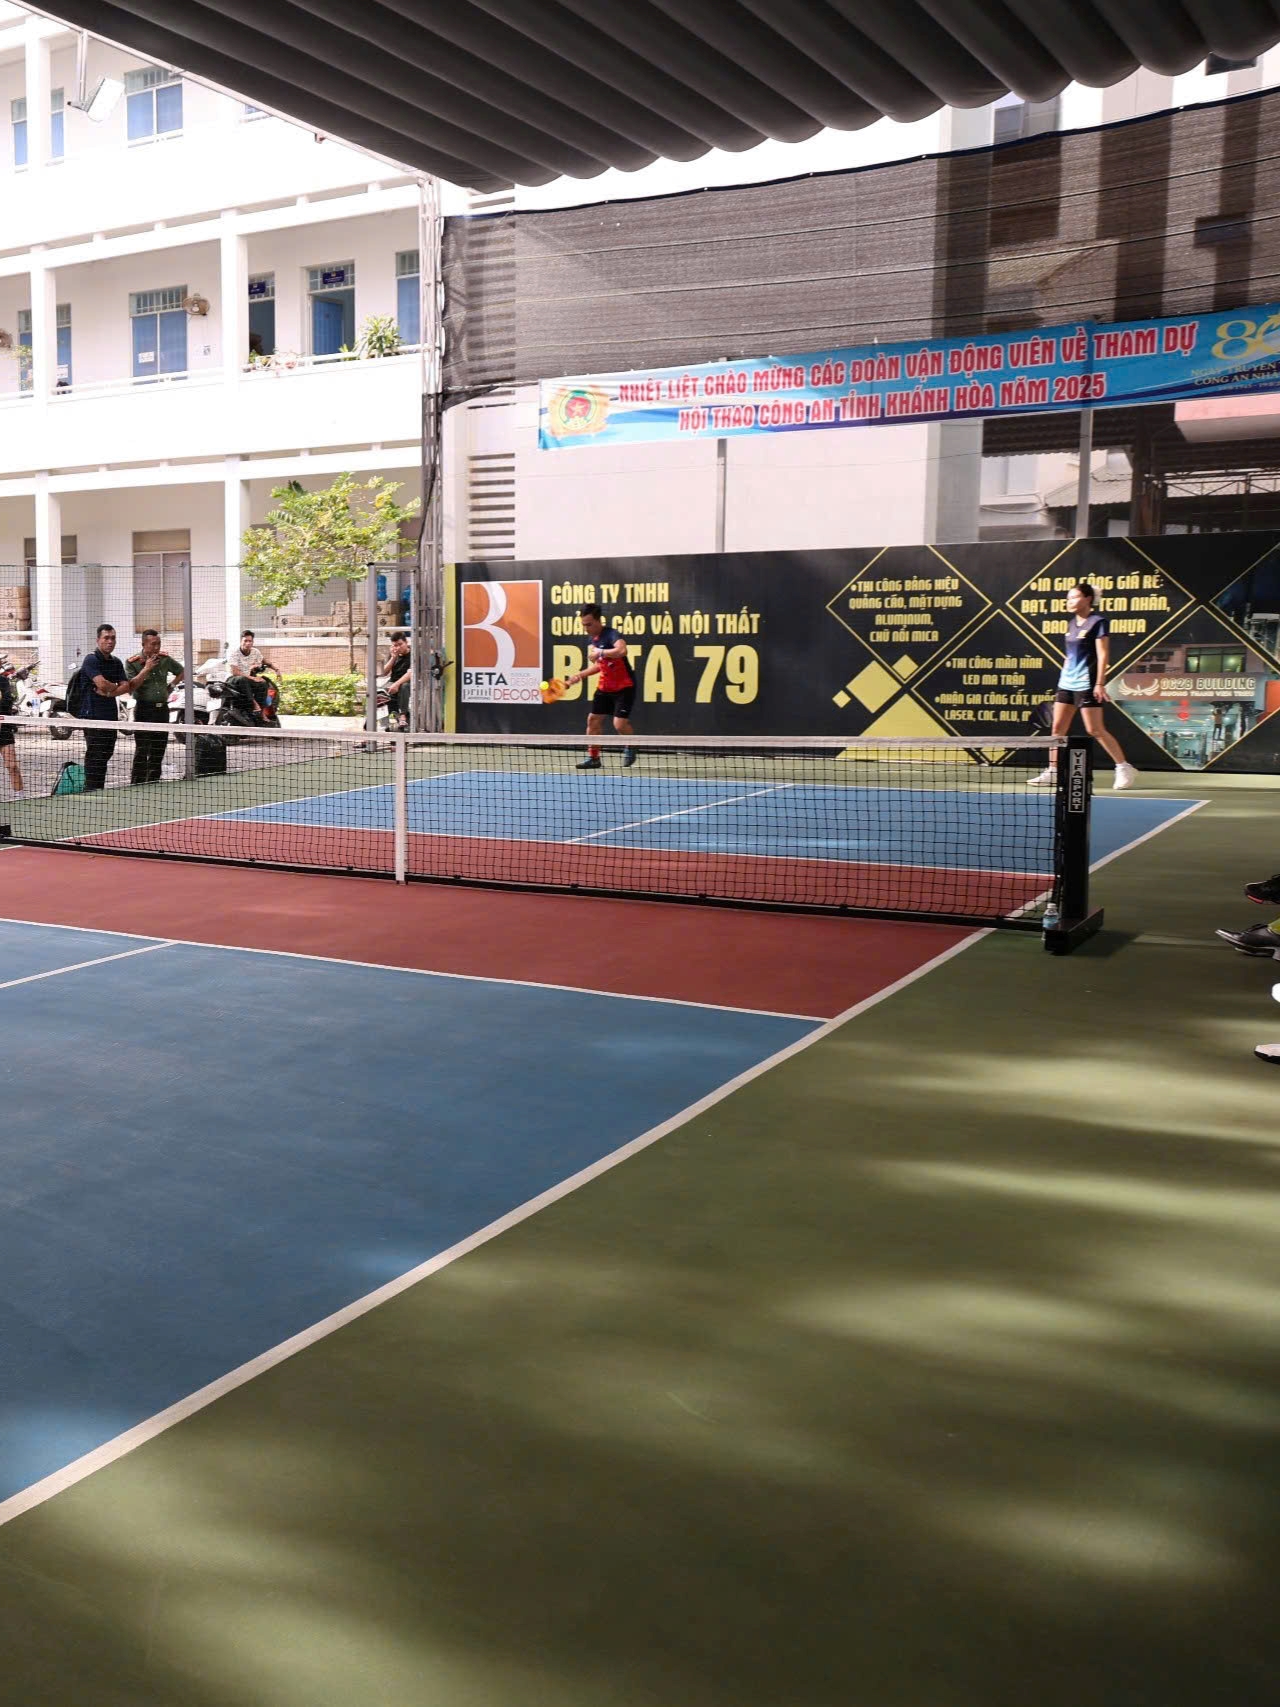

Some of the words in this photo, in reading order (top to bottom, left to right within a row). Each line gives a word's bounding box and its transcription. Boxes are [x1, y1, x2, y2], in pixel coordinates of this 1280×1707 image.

[668, 375, 698, 403] LIỆT
[704, 370, 747, 396] CHÀO
[753, 367, 805, 393] MỪNG
[811, 361, 844, 387] CÁC
[850, 352, 900, 384] ĐOÀN
[906, 349, 942, 383] VẬN
[949, 344, 1002, 379] ĐỘNG
[1009, 337, 1056, 369] VIÊN
[1062, 326, 1087, 362] VỀ
[1093, 328, 1156, 358] THAM
[1163, 321, 1199, 356] DỰ
[679, 407, 707, 435] HỘI
[759, 399, 805, 426] CÔNG
[809, 399, 834, 421] AN
[839, 390, 881, 420] TỈNH
[885, 381, 948, 417] KHÁNH
[955, 380, 994, 411] HÒA
[1000, 376, 1047, 408] NĂM
[1053, 372, 1106, 401] 2025
[857, 581, 873, 592] THI
[875, 577, 902, 592] CÔNG
[904, 575, 932, 591] BẢNG
[934, 576, 959, 592] HIỆU
[1116, 571, 1140, 590] GIÁ
[551, 581, 595, 604] CÔNG
[600, 584, 619, 604] TY
[624, 582, 669, 603] TNHH
[848, 593, 882, 610] QUẢNG
[1099, 597, 1127, 611] TEM
[651, 611, 674, 635] VÀ
[679, 610, 710, 638] NỘI
[715, 606, 760, 634] THẤT
[1042, 620, 1068, 634] BAO
[1109, 618, 1147, 637] NHỰA
[911, 630, 939, 642] MICA
[952, 657, 967, 669] THI
[968, 655, 993, 669] CÔNG
[463, 672, 508, 685] BETA
[693, 645, 759, 704] 79
[962, 674, 980, 686] LED
[981, 674, 998, 686] MA
[1196, 678, 1256, 690] BUILDING
[493, 689, 539, 701] DECOR
[966, 693, 982, 705] GIA
[983, 691, 1008, 705] CÔNG
